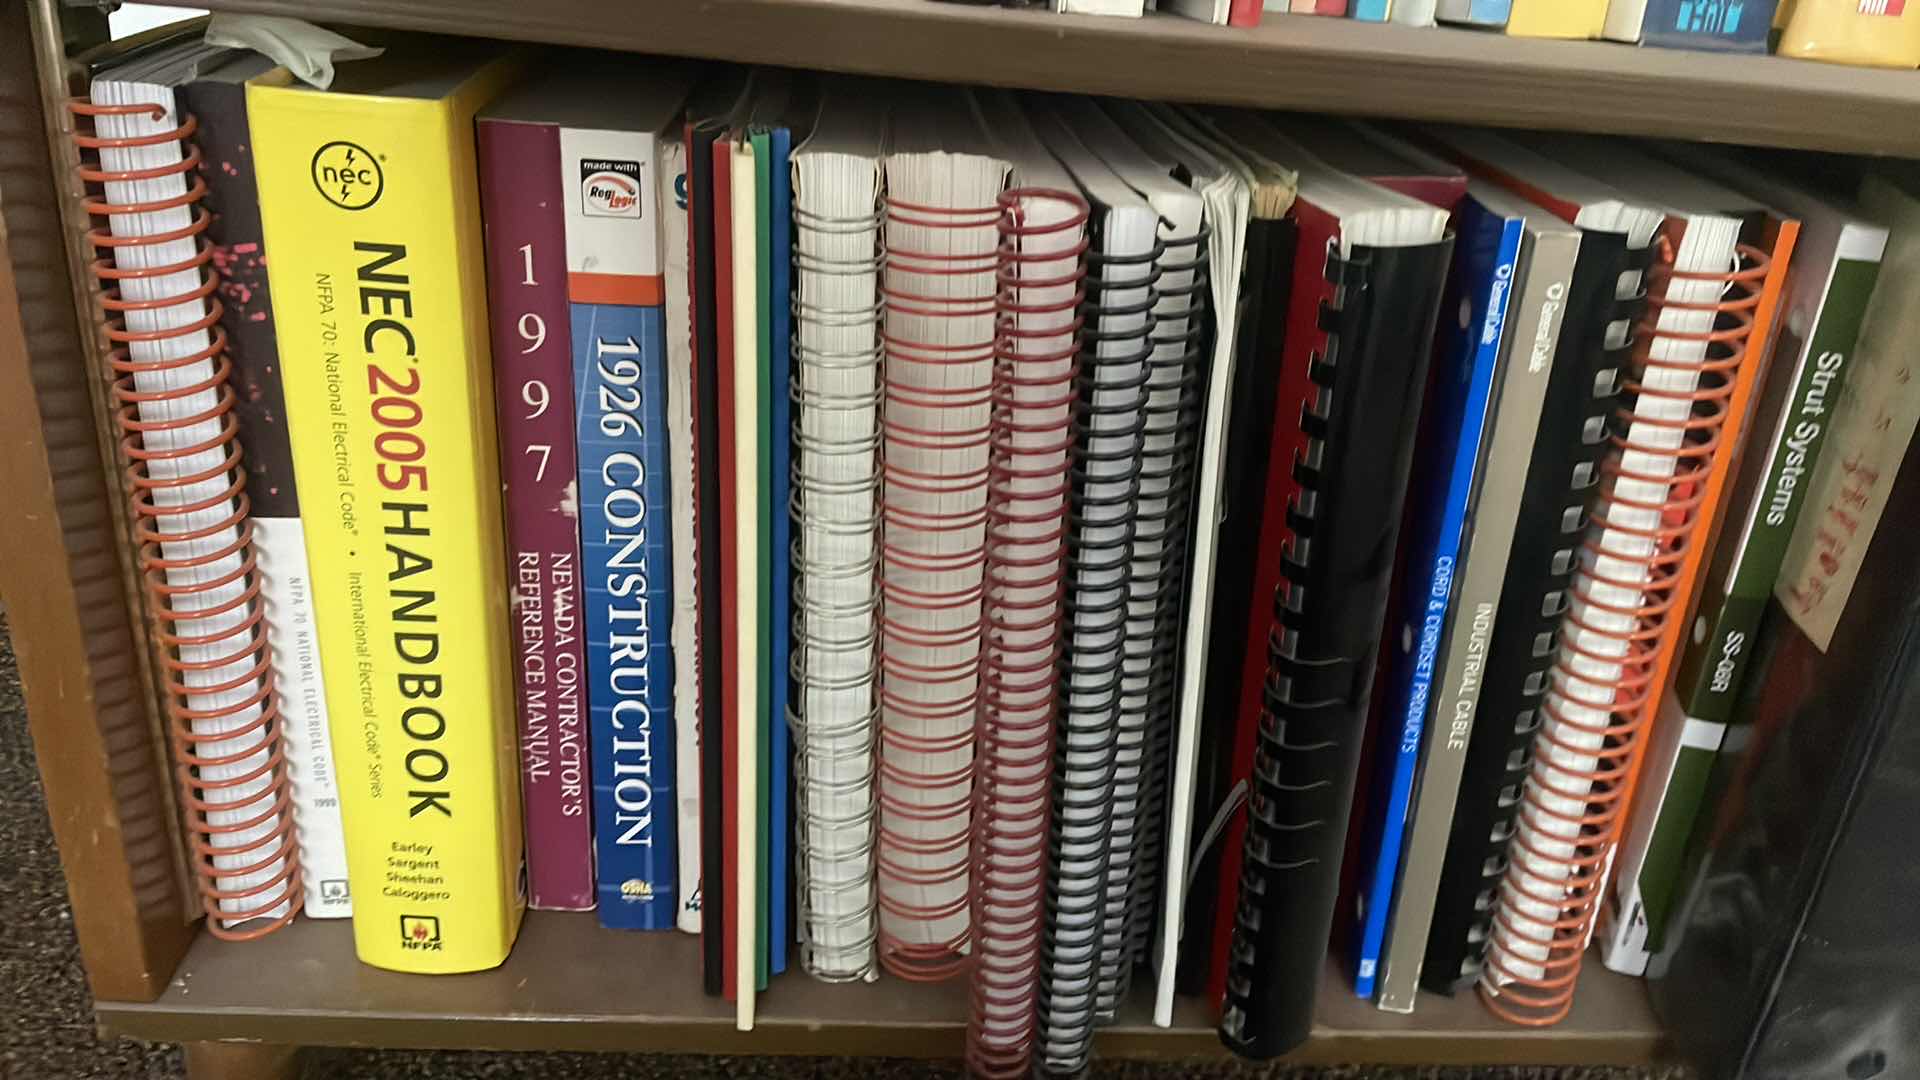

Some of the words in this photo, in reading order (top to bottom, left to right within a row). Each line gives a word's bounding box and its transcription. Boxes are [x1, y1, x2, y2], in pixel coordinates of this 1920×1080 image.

[323, 166, 372, 186] nec
[584, 161, 612, 171] made
[614, 163, 637, 172] with
[316, 273, 334, 314] NFPA
[353, 241, 416, 356] NEC
[325, 352, 346, 416] National
[597, 336, 643, 437] 1926
[1802, 351, 1843, 417] Strut
[332, 421, 354, 487] Electrical
[367, 364, 428, 491] 2005
[1766, 421, 1820, 527] Systems
[288, 577, 303, 605] NFPA
[551, 553, 576, 646] NEVADA
[1428, 600, 1444, 611] &
[1431, 556, 1452, 598] CORD
[293, 612, 307, 624] 70
[349, 572, 369, 658] International
[519, 552, 545, 684] REFERENCE
[1415, 615, 1441, 678] CORDSET
[296, 630, 315, 682] NATIONAL
[382, 502, 452, 818] HANDBOOK
[602, 452, 655, 847] CONSTRUCTION
[1458, 603, 1493, 697] INDUSTRIAL
[303, 687, 325, 752] ELECTRICAL
[358, 661, 376, 718] Electrical
[1401, 682, 1428, 753] PRODUCTS
[525, 690, 550, 783] MANUAL
[556, 653, 582, 817] CONTRACTOR'S
[1447, 700, 1472, 750] CABLE
[368, 763, 382, 799] Series
[386, 872, 444, 884] Sheehan
[387, 856, 440, 870] Sargent
[391, 841, 433, 856] Earley
[382, 886, 451, 901] Caloggero
[401, 940, 442, 951] NFPA
